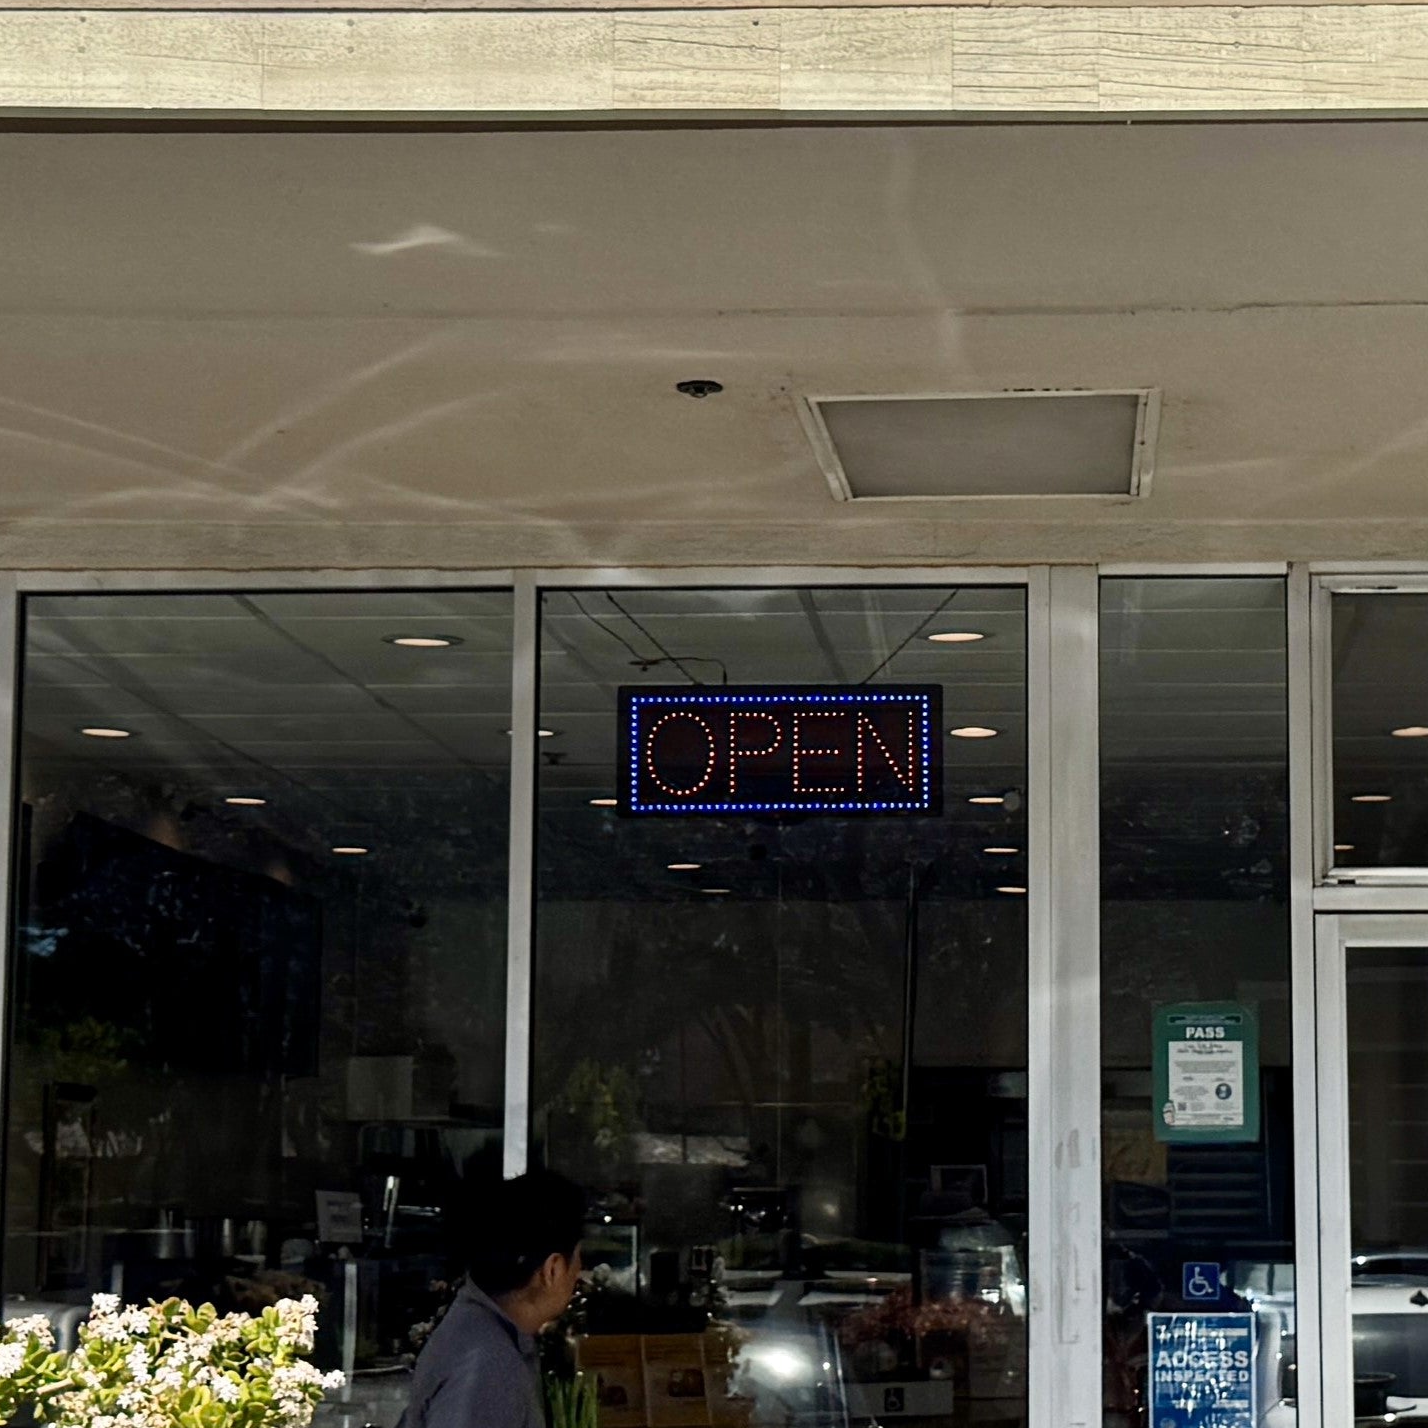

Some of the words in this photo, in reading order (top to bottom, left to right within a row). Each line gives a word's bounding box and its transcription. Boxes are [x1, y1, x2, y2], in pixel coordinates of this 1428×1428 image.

[646, 711, 915, 795] OPEN
[1185, 1026, 1226, 1039] PASS
[1155, 1350, 1250, 1369] ACCESS
[1154, 1370, 1250, 1383] INSPECTED
